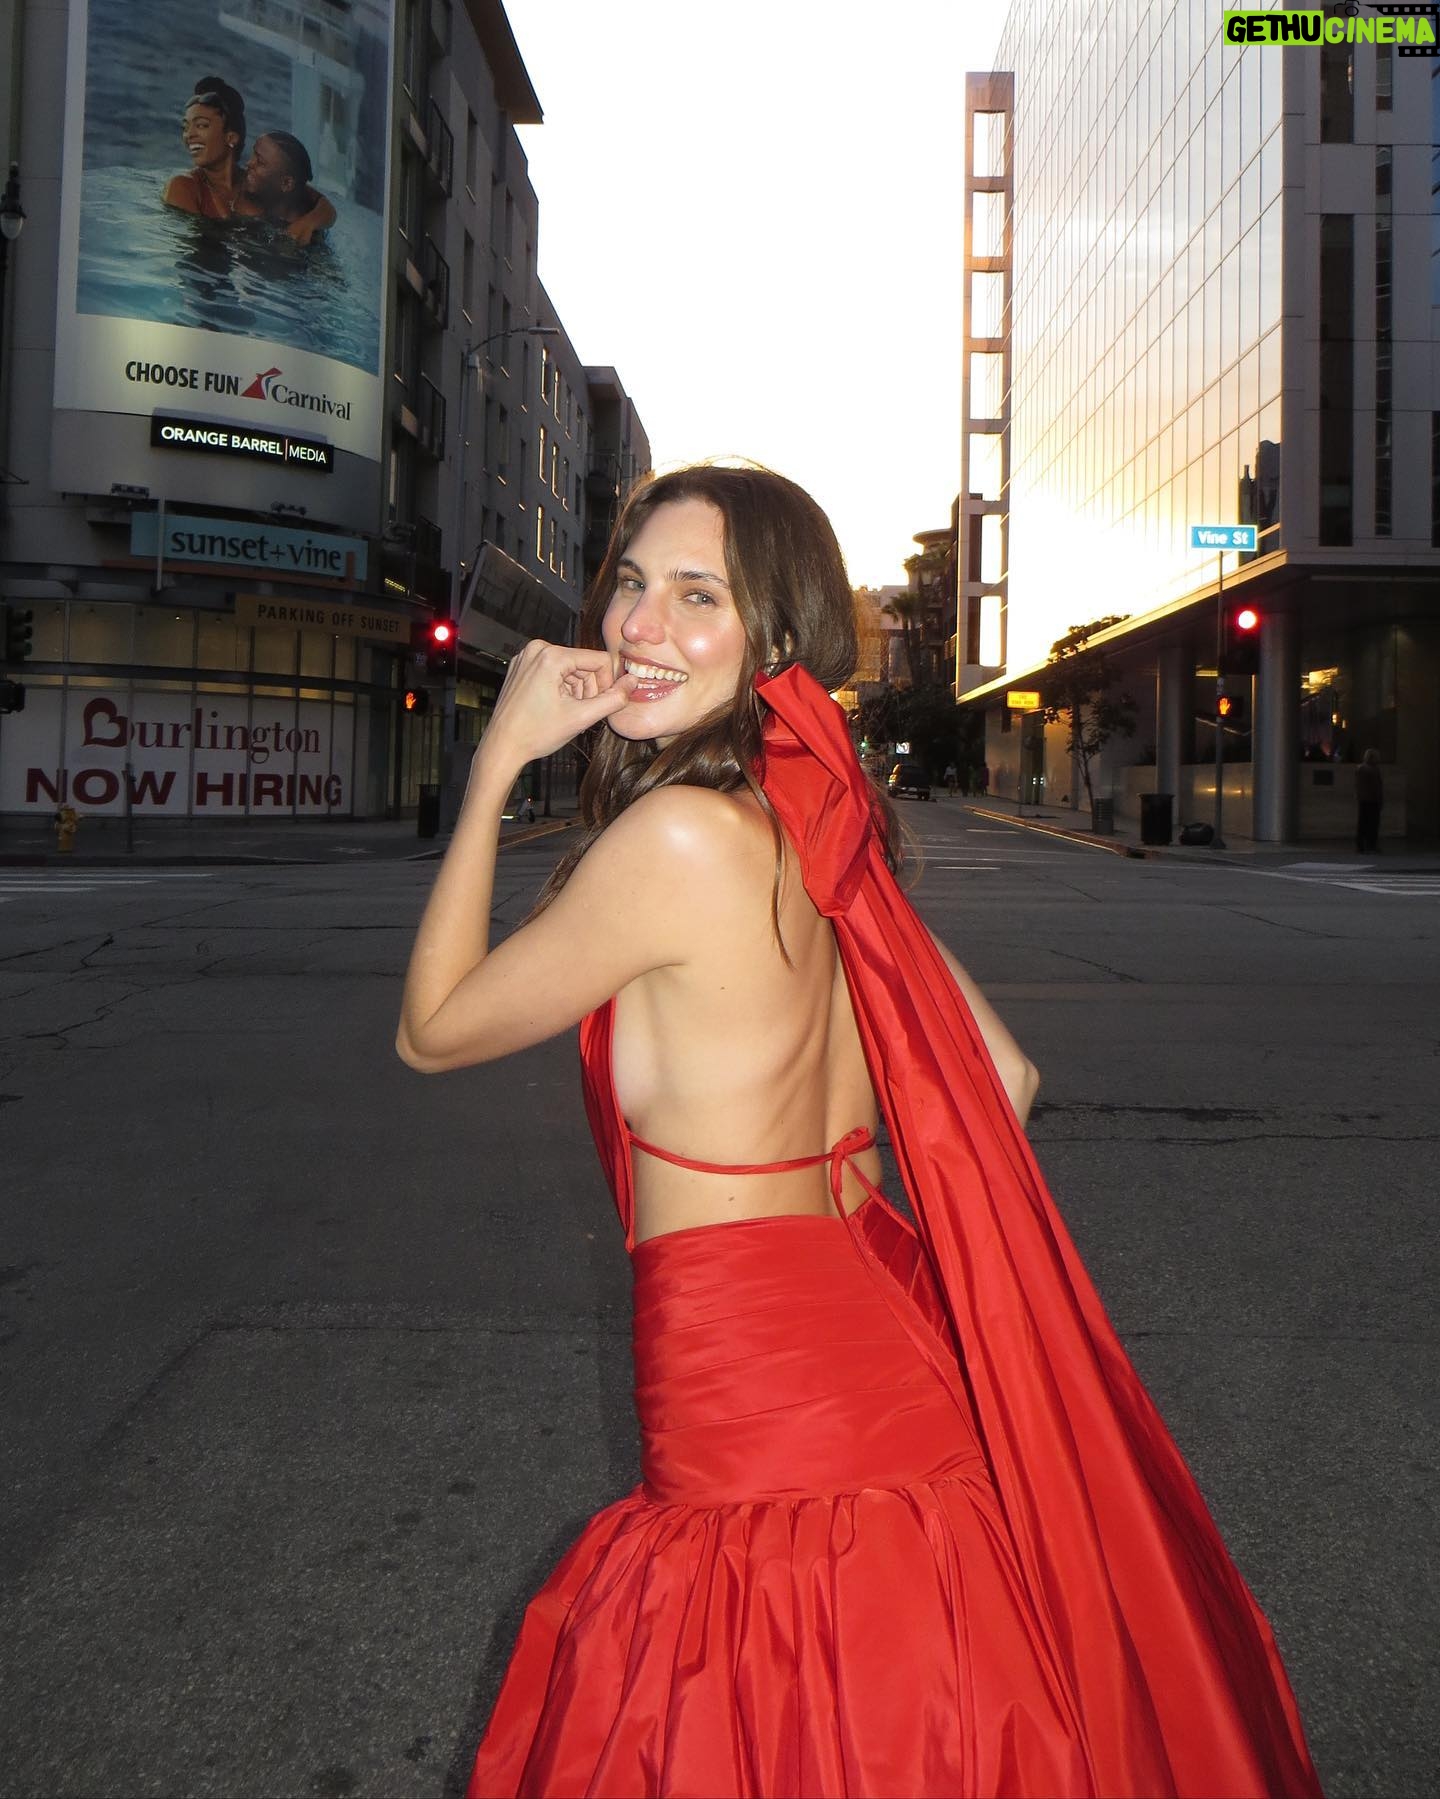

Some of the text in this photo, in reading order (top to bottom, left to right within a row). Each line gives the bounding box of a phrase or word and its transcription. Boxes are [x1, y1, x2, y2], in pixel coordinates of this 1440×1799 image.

[125, 360, 239, 396] CHOOSE FUN
[271, 384, 351, 421] Carnival
[160, 425, 327, 464] ORANGE BARREL MEDIA
[1197, 530, 1249, 545] Vine St
[257, 603, 400, 633] PARKING OFF SUNSET
[81, 697, 321, 765] Burlington
[25, 767, 342, 807] NOW HIRING
